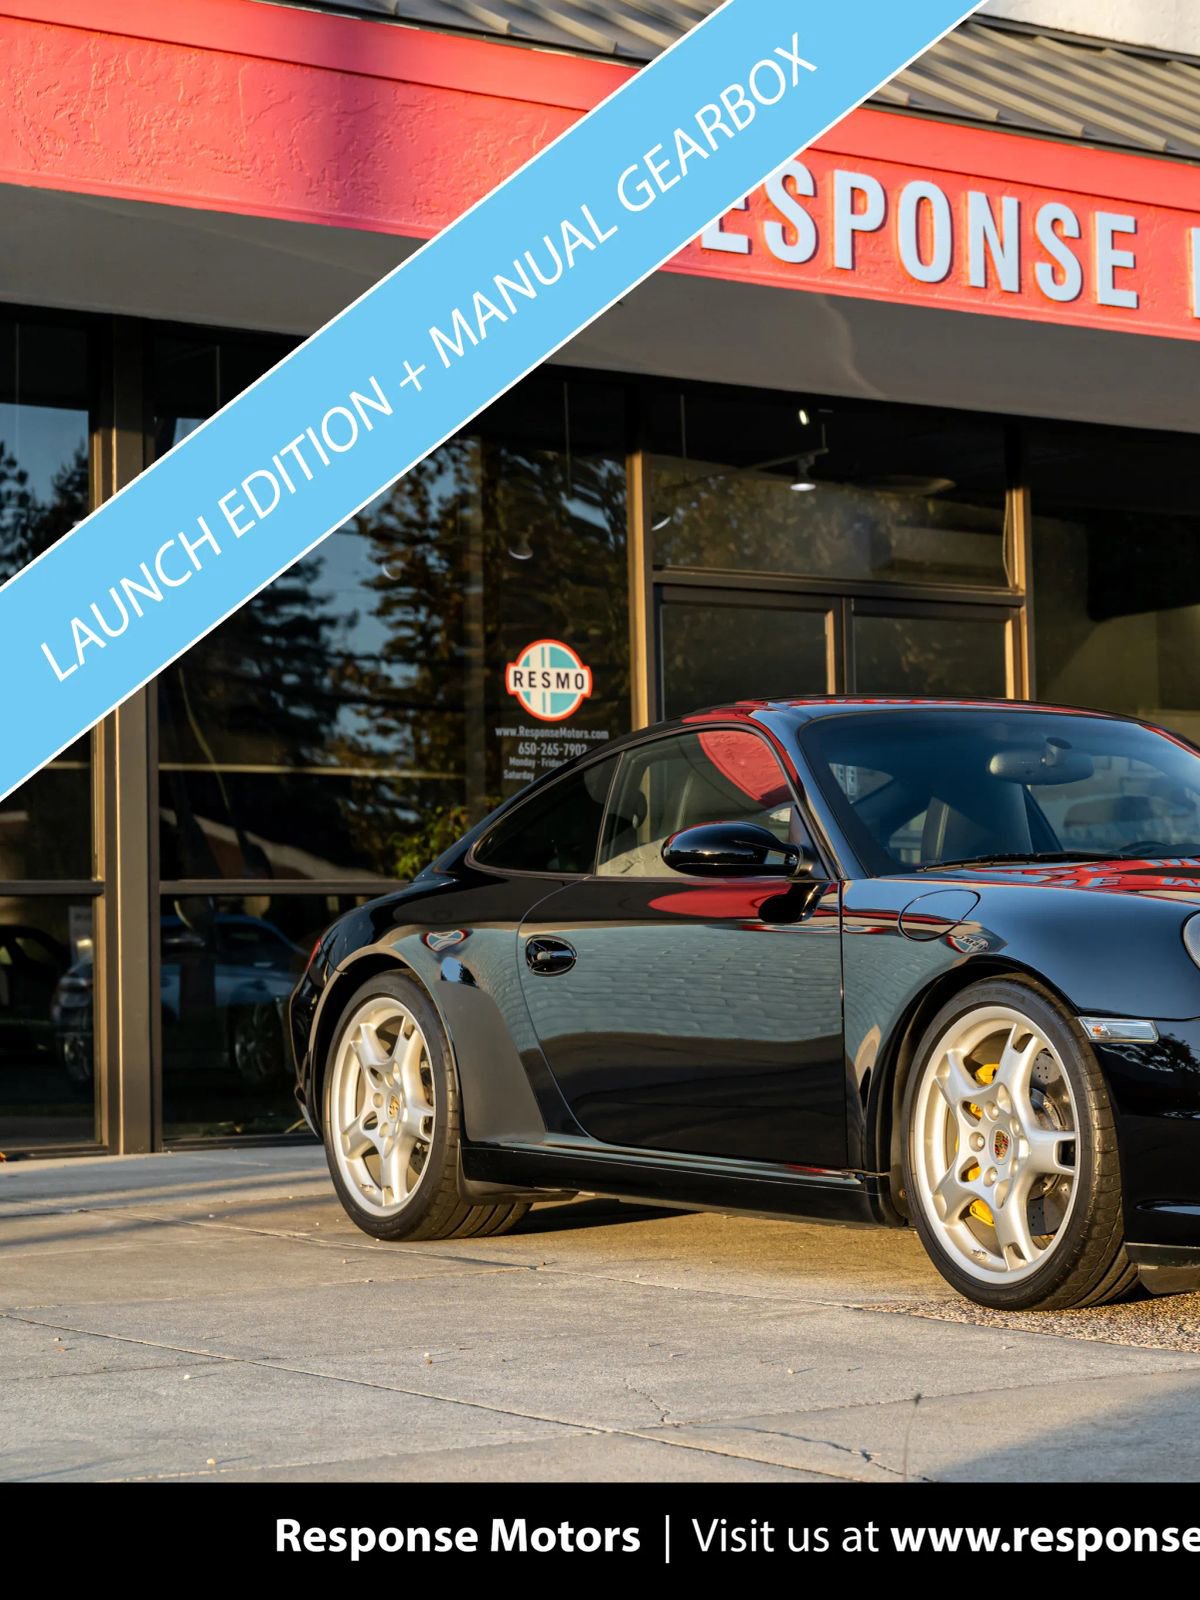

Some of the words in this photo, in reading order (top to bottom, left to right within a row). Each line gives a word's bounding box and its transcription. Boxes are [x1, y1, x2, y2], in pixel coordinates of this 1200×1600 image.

[513, 670, 585, 690] RESMO
[495, 725, 609, 740] www.ResponseMotors.com
[518, 742, 588, 756] 650-265-7902
[509, 756, 536, 768] Monday
[503, 769, 535, 781] Saturday
